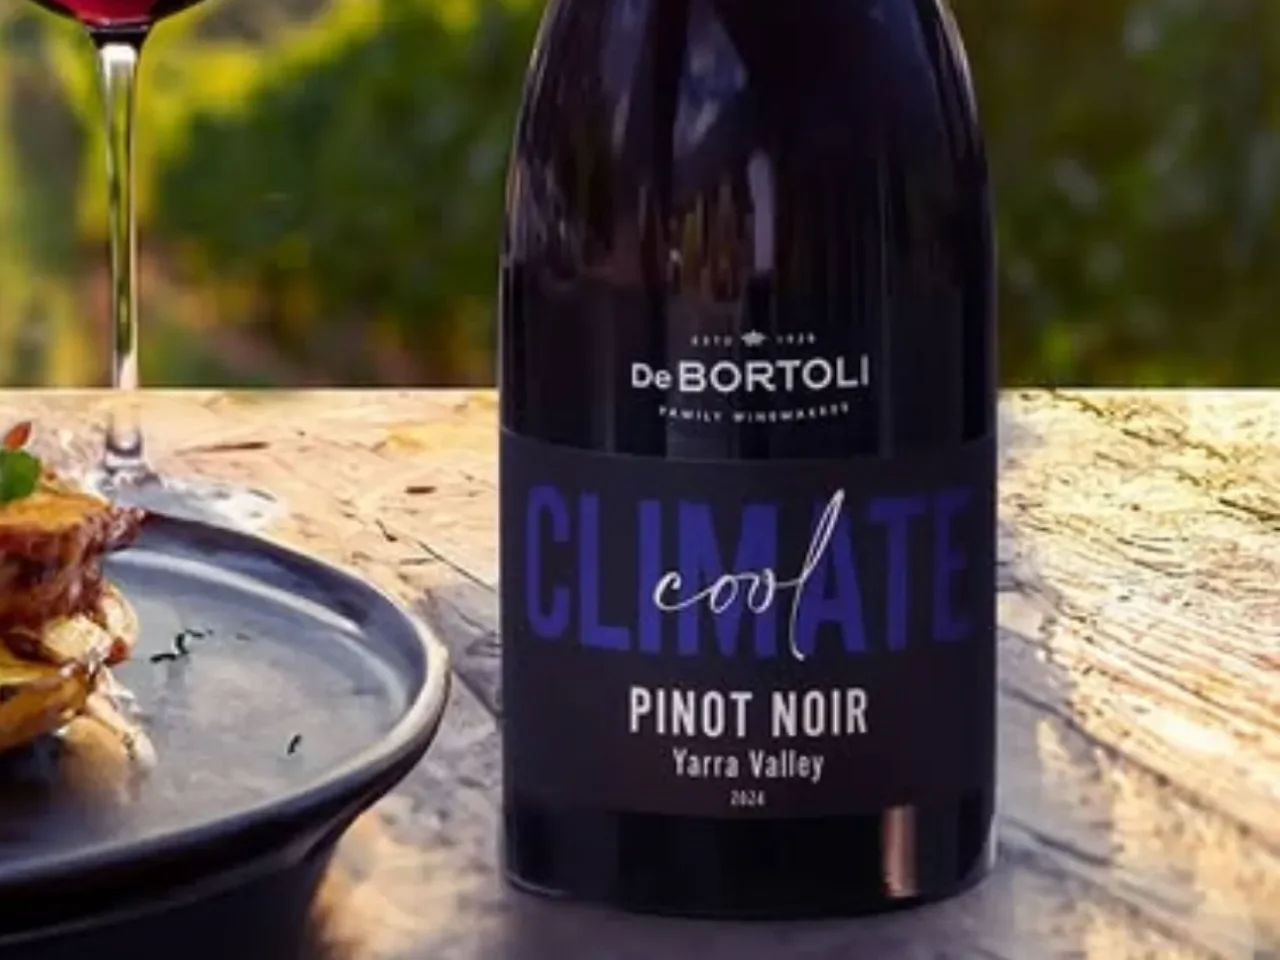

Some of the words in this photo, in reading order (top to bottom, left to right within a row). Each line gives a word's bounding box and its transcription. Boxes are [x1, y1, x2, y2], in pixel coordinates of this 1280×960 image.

[525, 484, 974, 657] CLIMATE
[654, 488, 845, 660] cool
[630, 685, 753, 738] PINOT
[771, 687, 868, 738] NOIR
[673, 747, 739, 779] Yarra
[749, 749, 824, 784] Valley
